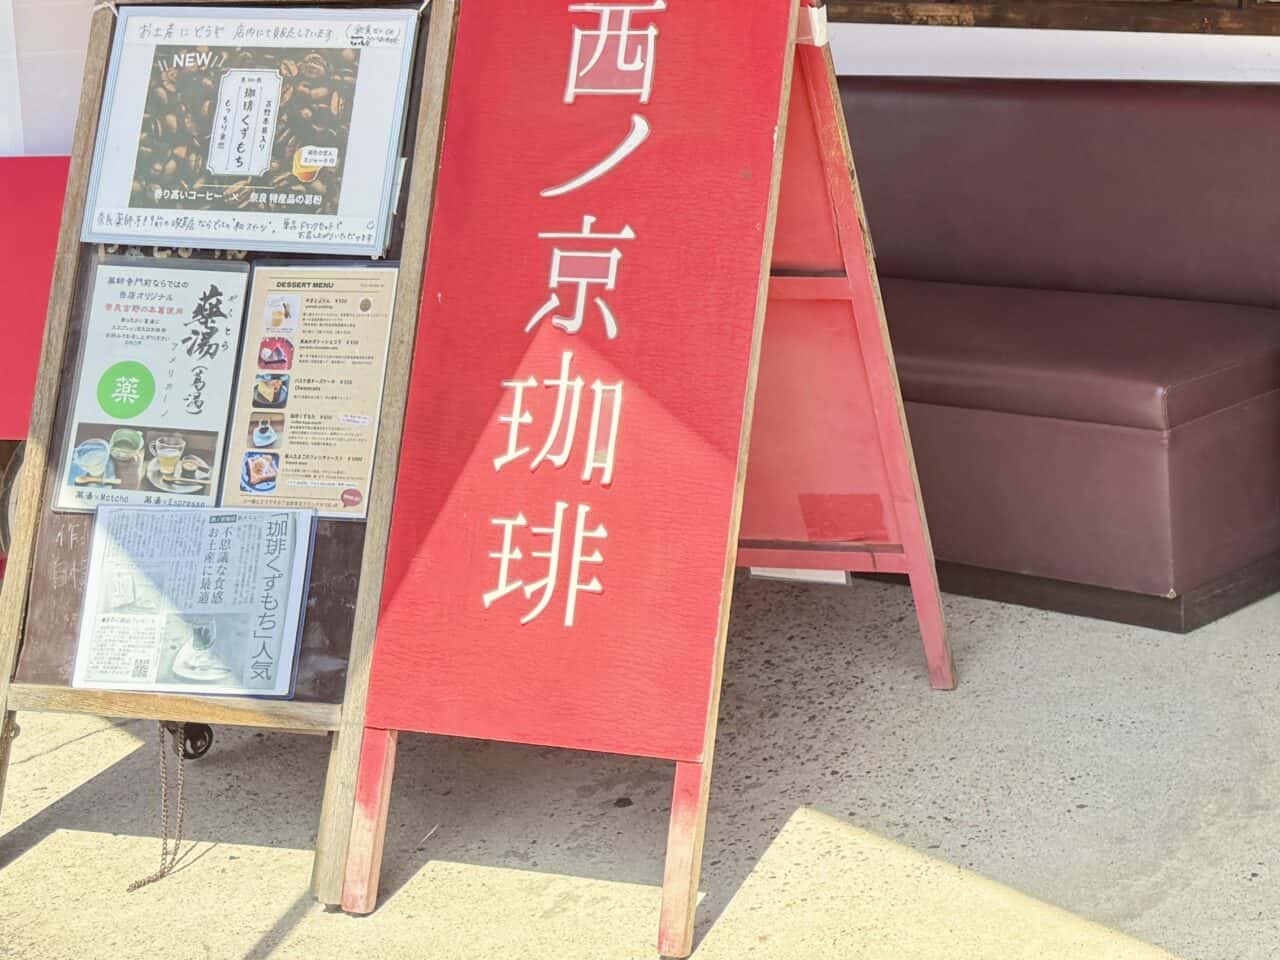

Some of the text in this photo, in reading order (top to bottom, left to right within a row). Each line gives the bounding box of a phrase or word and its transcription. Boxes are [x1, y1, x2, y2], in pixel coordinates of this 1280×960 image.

[173, 51, 212, 68] NEW
[154, 189, 223, 200] 香り高いコーヒー
[111, 375, 140, 404] 薬
[198, 527, 220, 604] お土産に最適
[211, 527, 233, 604] 不思議な食感
[251, 513, 289, 681] 「珈琲くずもち」人気
